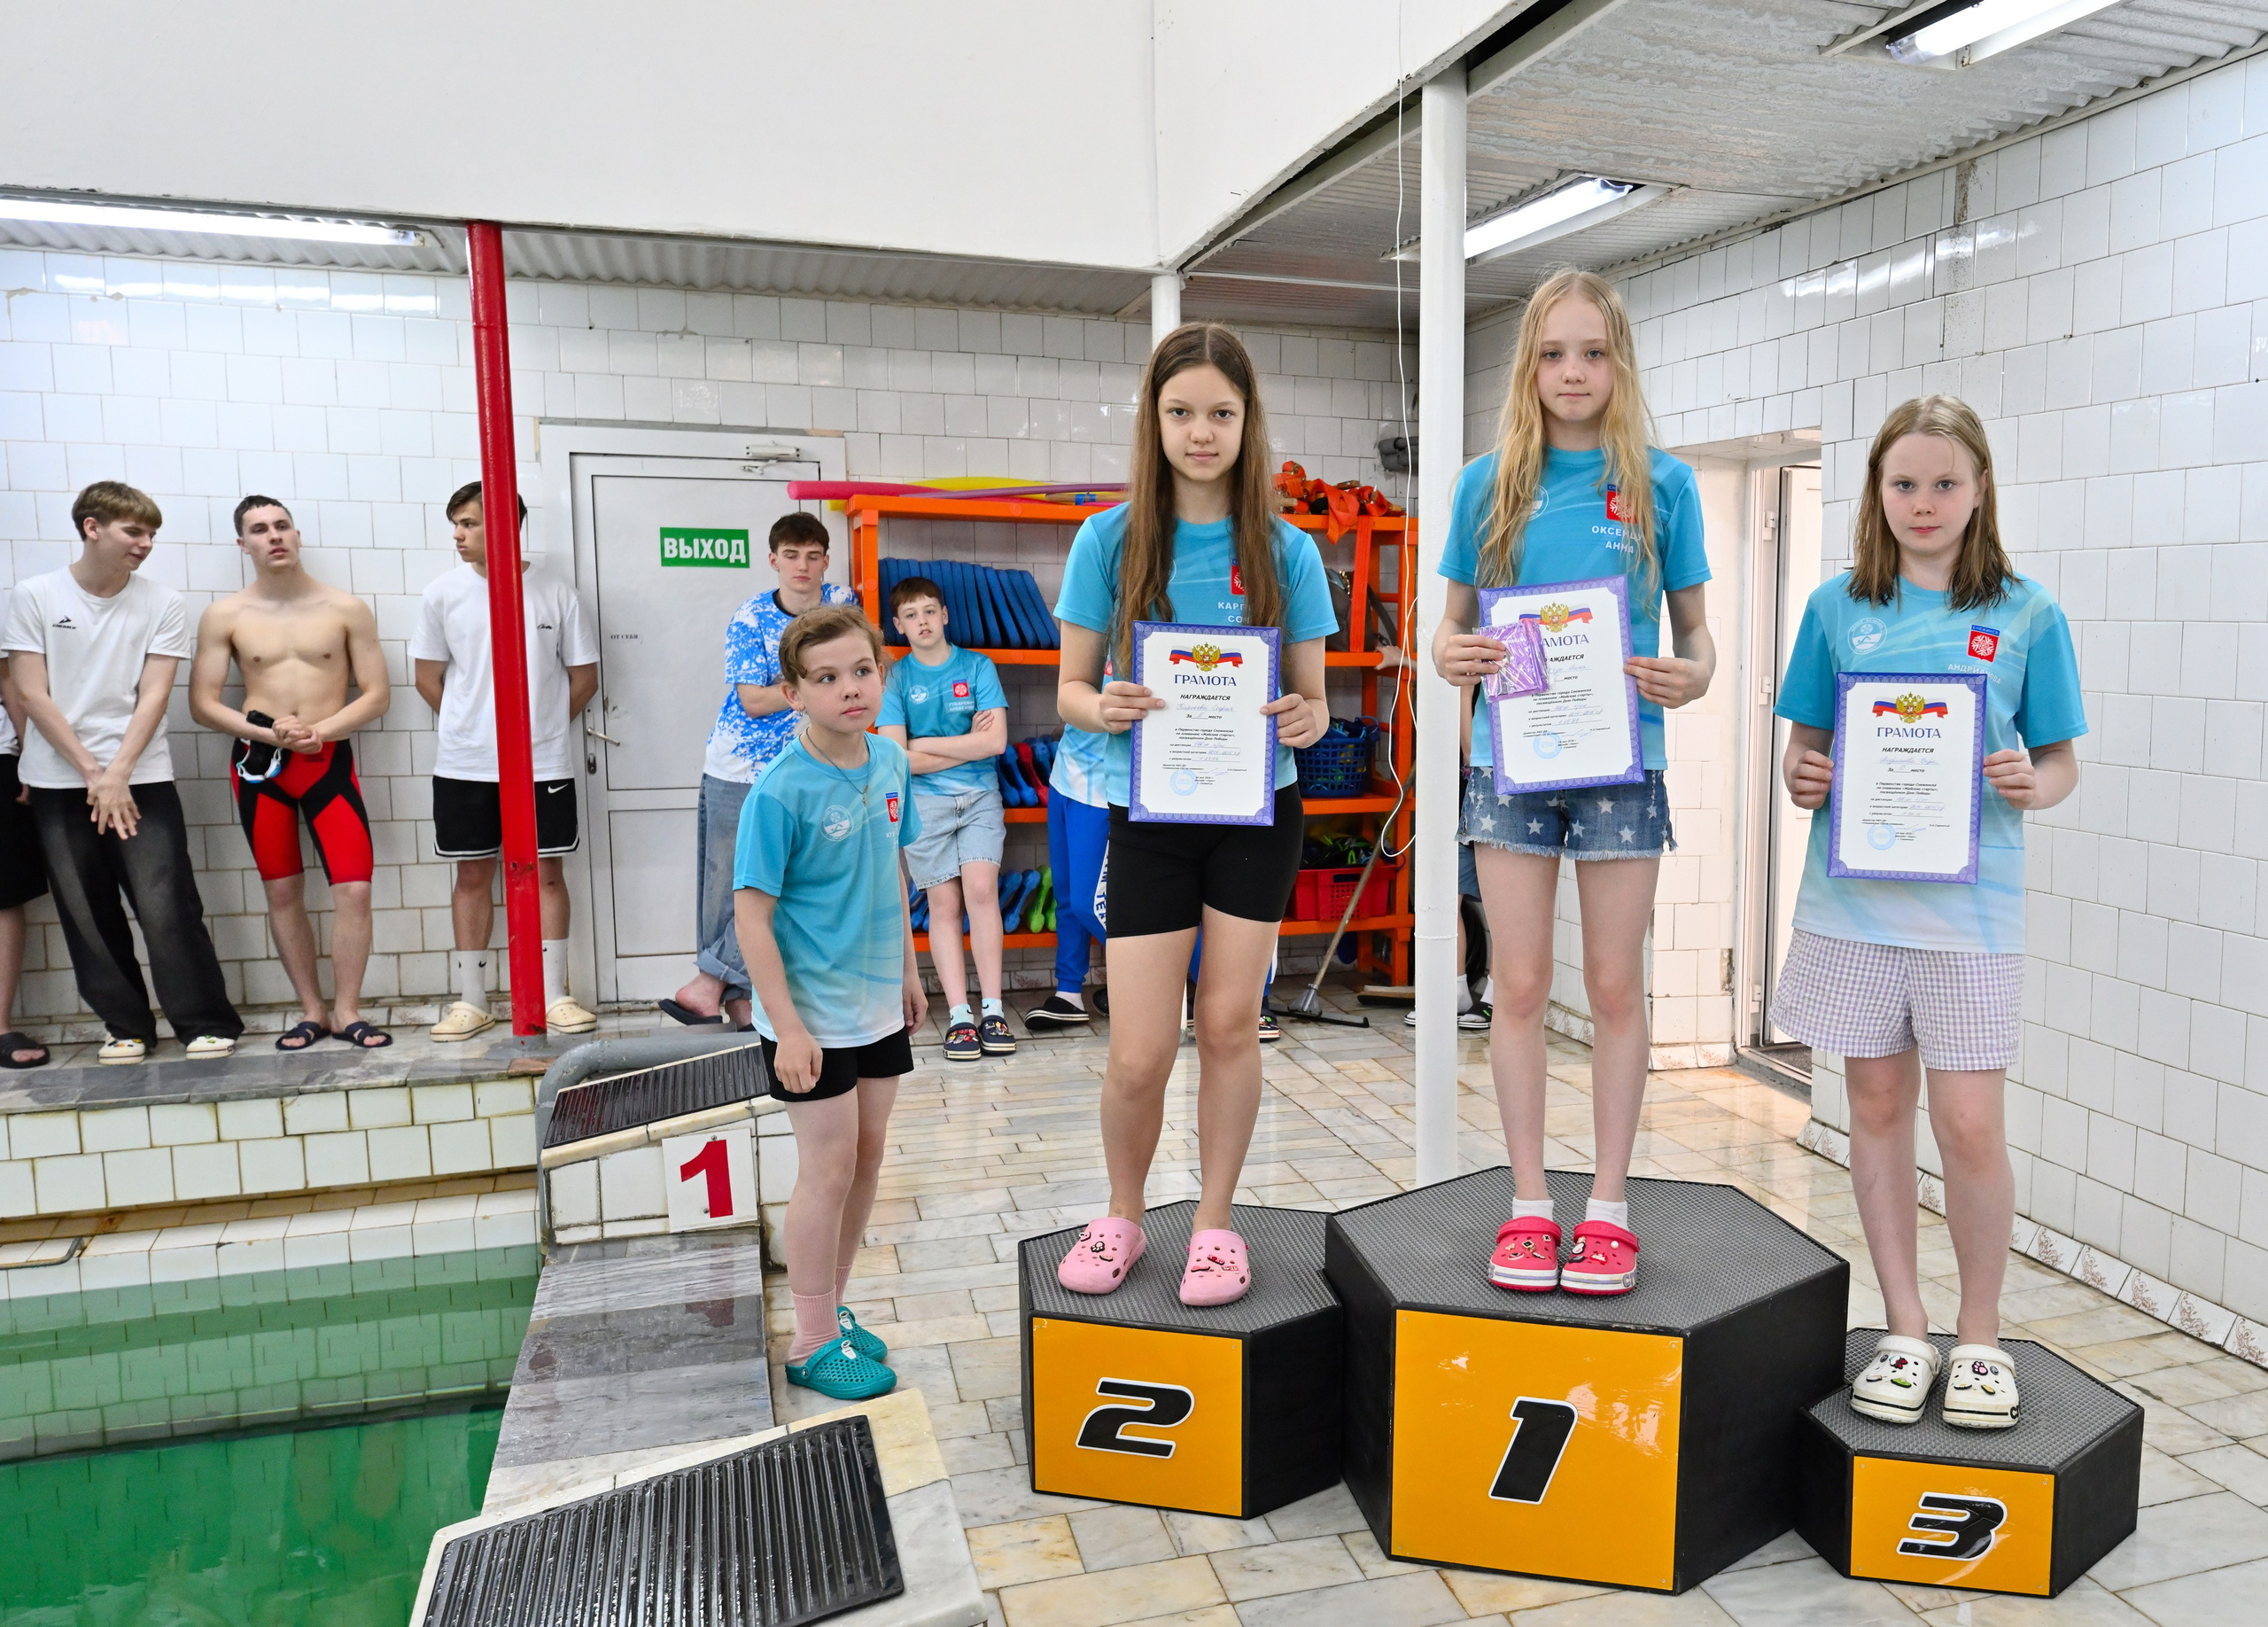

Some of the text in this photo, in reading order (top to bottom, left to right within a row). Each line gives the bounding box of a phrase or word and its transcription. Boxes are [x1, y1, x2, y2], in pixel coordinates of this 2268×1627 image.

[664, 537, 746, 564] ВЫХОД
[1605, 541, 1634, 554] АННА
[1542, 634, 1589, 647] АМОТА
[1550, 654, 1584, 663] АЖДАЕТСЯ
[1175, 674, 1237, 686] ГРАМОТА
[1877, 728, 1941, 738] ГРАМОТА
[680, 1139, 734, 1218] 1
[1076, 1377, 1195, 1459] 2
[1488, 1396, 1578, 1505] 1
[1897, 1491, 2008, 1561] 3
